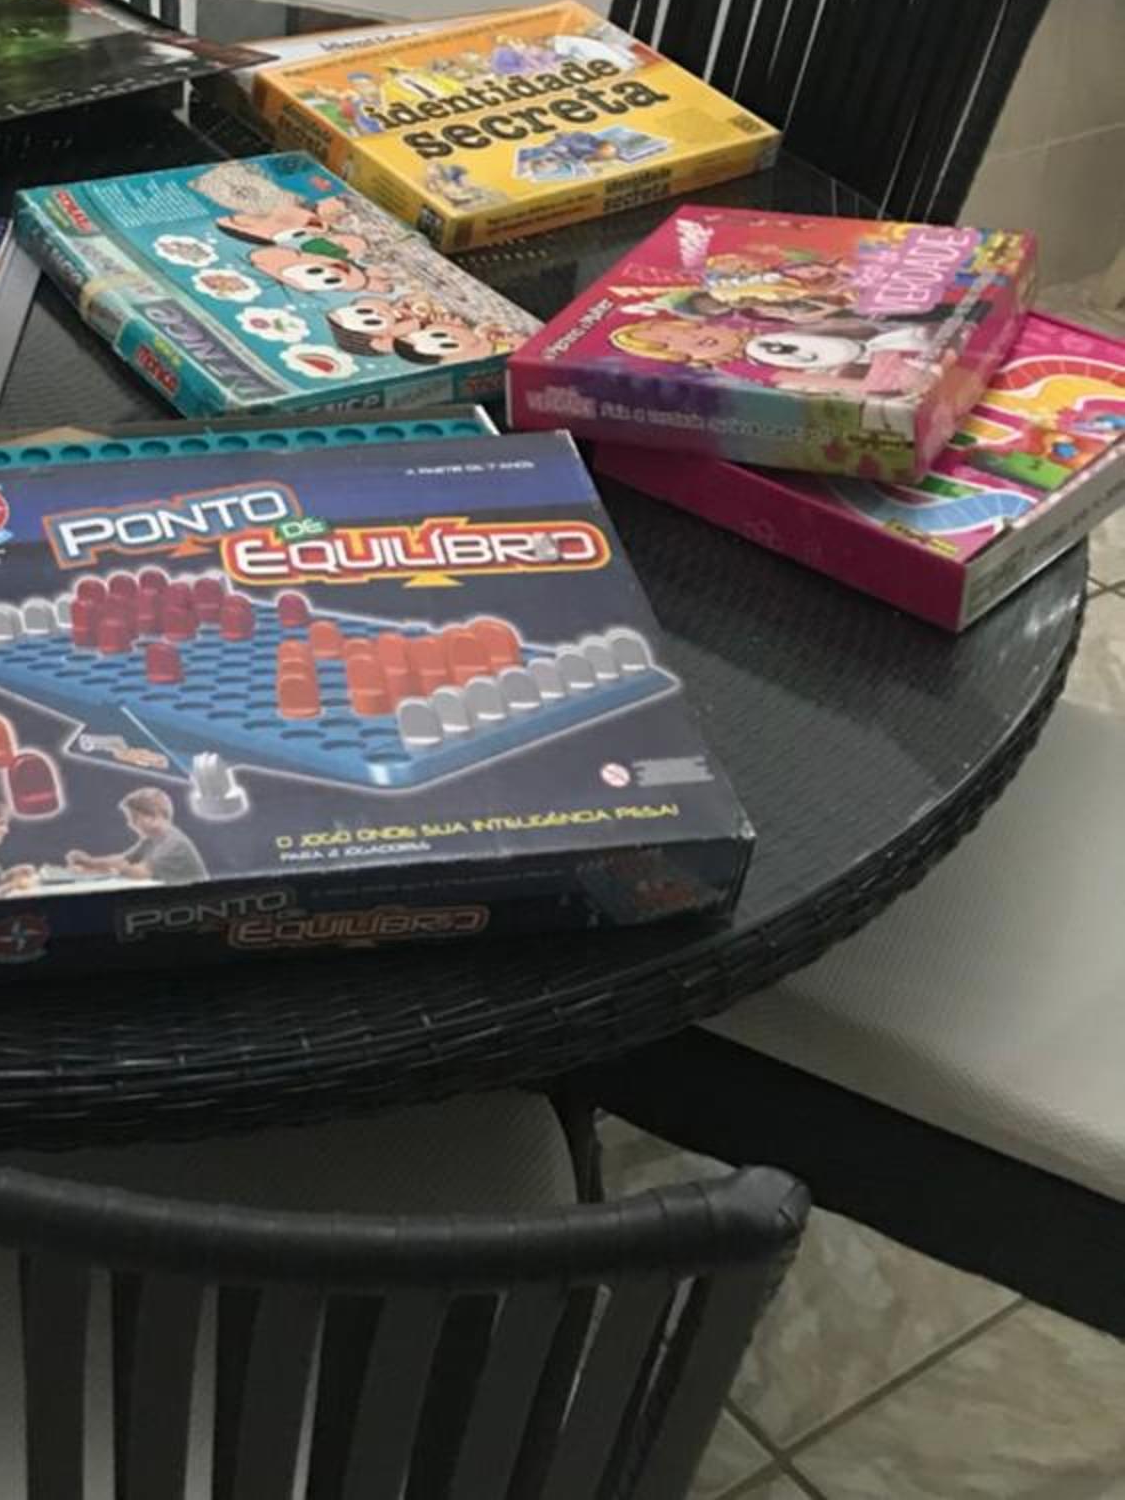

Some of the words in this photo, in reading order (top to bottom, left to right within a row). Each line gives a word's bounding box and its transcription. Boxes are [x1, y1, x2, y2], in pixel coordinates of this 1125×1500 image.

[366, 55, 621, 130] identidade
[403, 76, 670, 161] secreta
[58, 490, 288, 558] PONTO
[421, 820, 469, 837] SUA
[125, 891, 288, 934] PONTO
